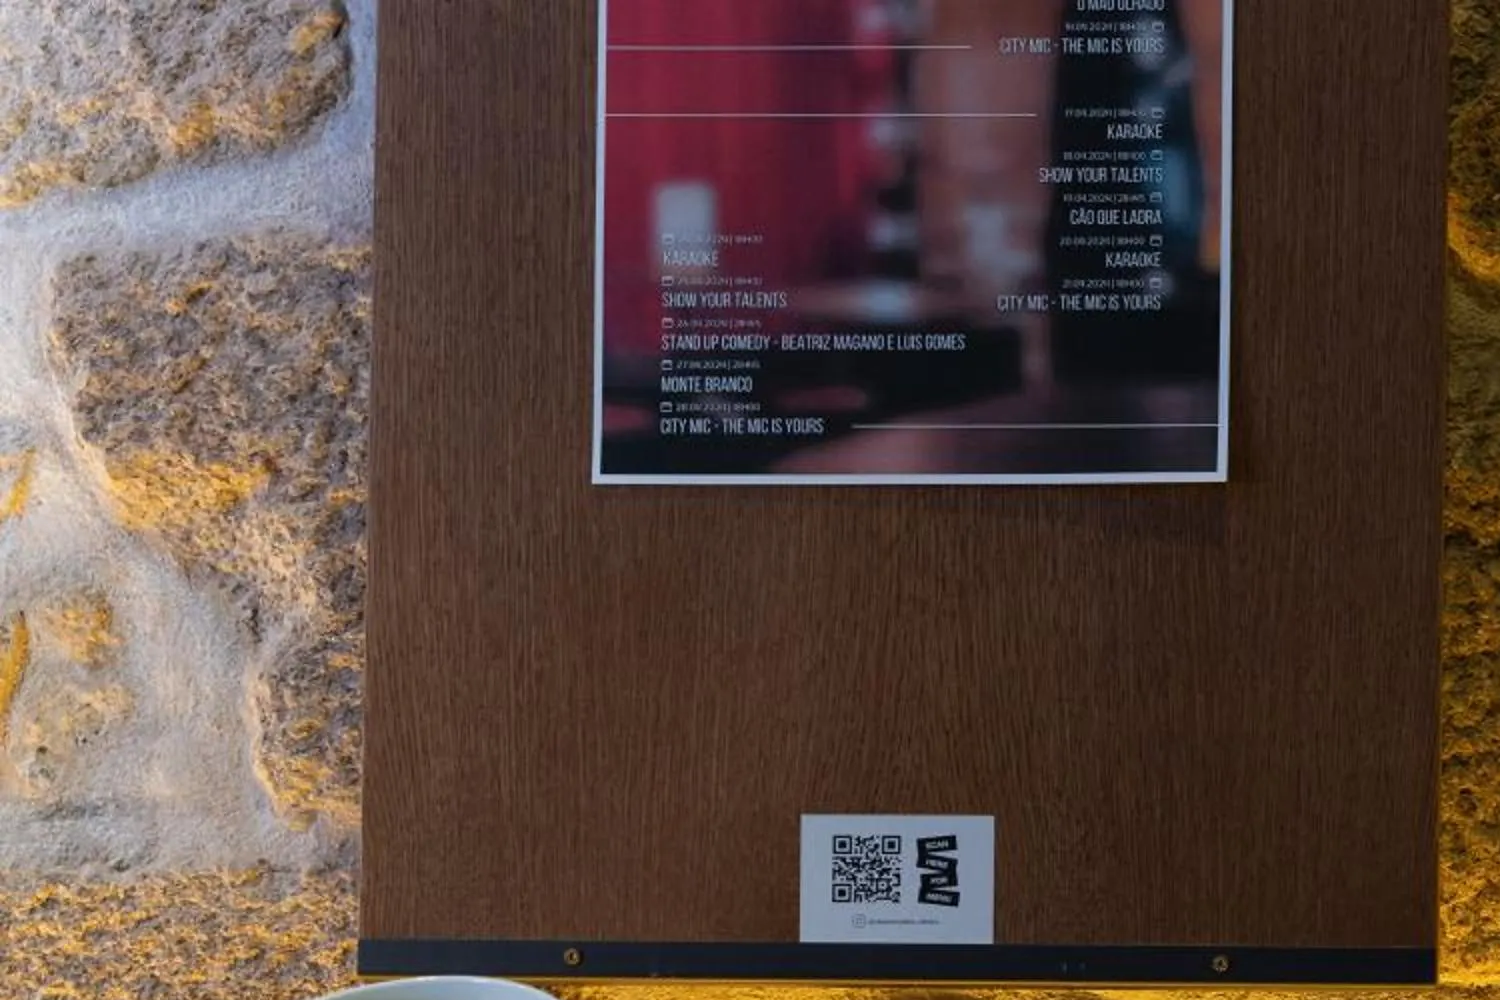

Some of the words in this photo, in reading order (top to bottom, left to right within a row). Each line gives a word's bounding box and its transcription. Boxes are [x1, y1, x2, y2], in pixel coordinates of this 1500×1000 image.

[1000, 37, 1027, 54] CITY
[1029, 37, 1051, 54] MIC
[1062, 37, 1084, 54] THE
[1087, 37, 1109, 54] MIC
[1111, 37, 1123, 54] IS
[1125, 37, 1165, 54] YOURS
[1106, 123, 1164, 140] KARAOKE
[1039, 166, 1073, 184] SHOW
[1075, 166, 1108, 184] YOUR
[1110, 166, 1164, 184] TALENTS
[1069, 207, 1095, 226] CÃO
[1097, 208, 1121, 226] QUE
[1122, 208, 1164, 226] LADRA
[663, 250, 719, 267] KARAOKE
[1104, 251, 1162, 268] KARAOKE
[661, 290, 698, 308] SHOW
[700, 290, 732, 308] YOUR
[734, 290, 788, 308] TALENTS
[996, 294, 1024, 311] CITY
[1027, 294, 1049, 311] MIC
[1060, 294, 1082, 311] THE
[1084, 294, 1107, 311] MIC
[1109, 294, 1120, 311] IS
[1122, 294, 1162, 311] YOURS
[661, 333, 701, 350] STAND
[703, 333, 719, 350] UP
[721, 333, 771, 350] COMEDY
[781, 333, 831, 351] BEATRIZ
[833, 333, 885, 350] MAGANO
[887, 334, 895, 350] E
[897, 334, 923, 350] LUIS
[924, 334, 967, 350] GOMES
[660, 375, 702, 392] MONTE
[704, 375, 753, 392] BRANCO
[660, 417, 687, 434] CITY
[689, 417, 711, 434] MIC
[722, 417, 745, 434] THE
[747, 417, 769, 434] MIC
[771, 417, 783, 434] IS
[785, 417, 825, 434] YOURS
